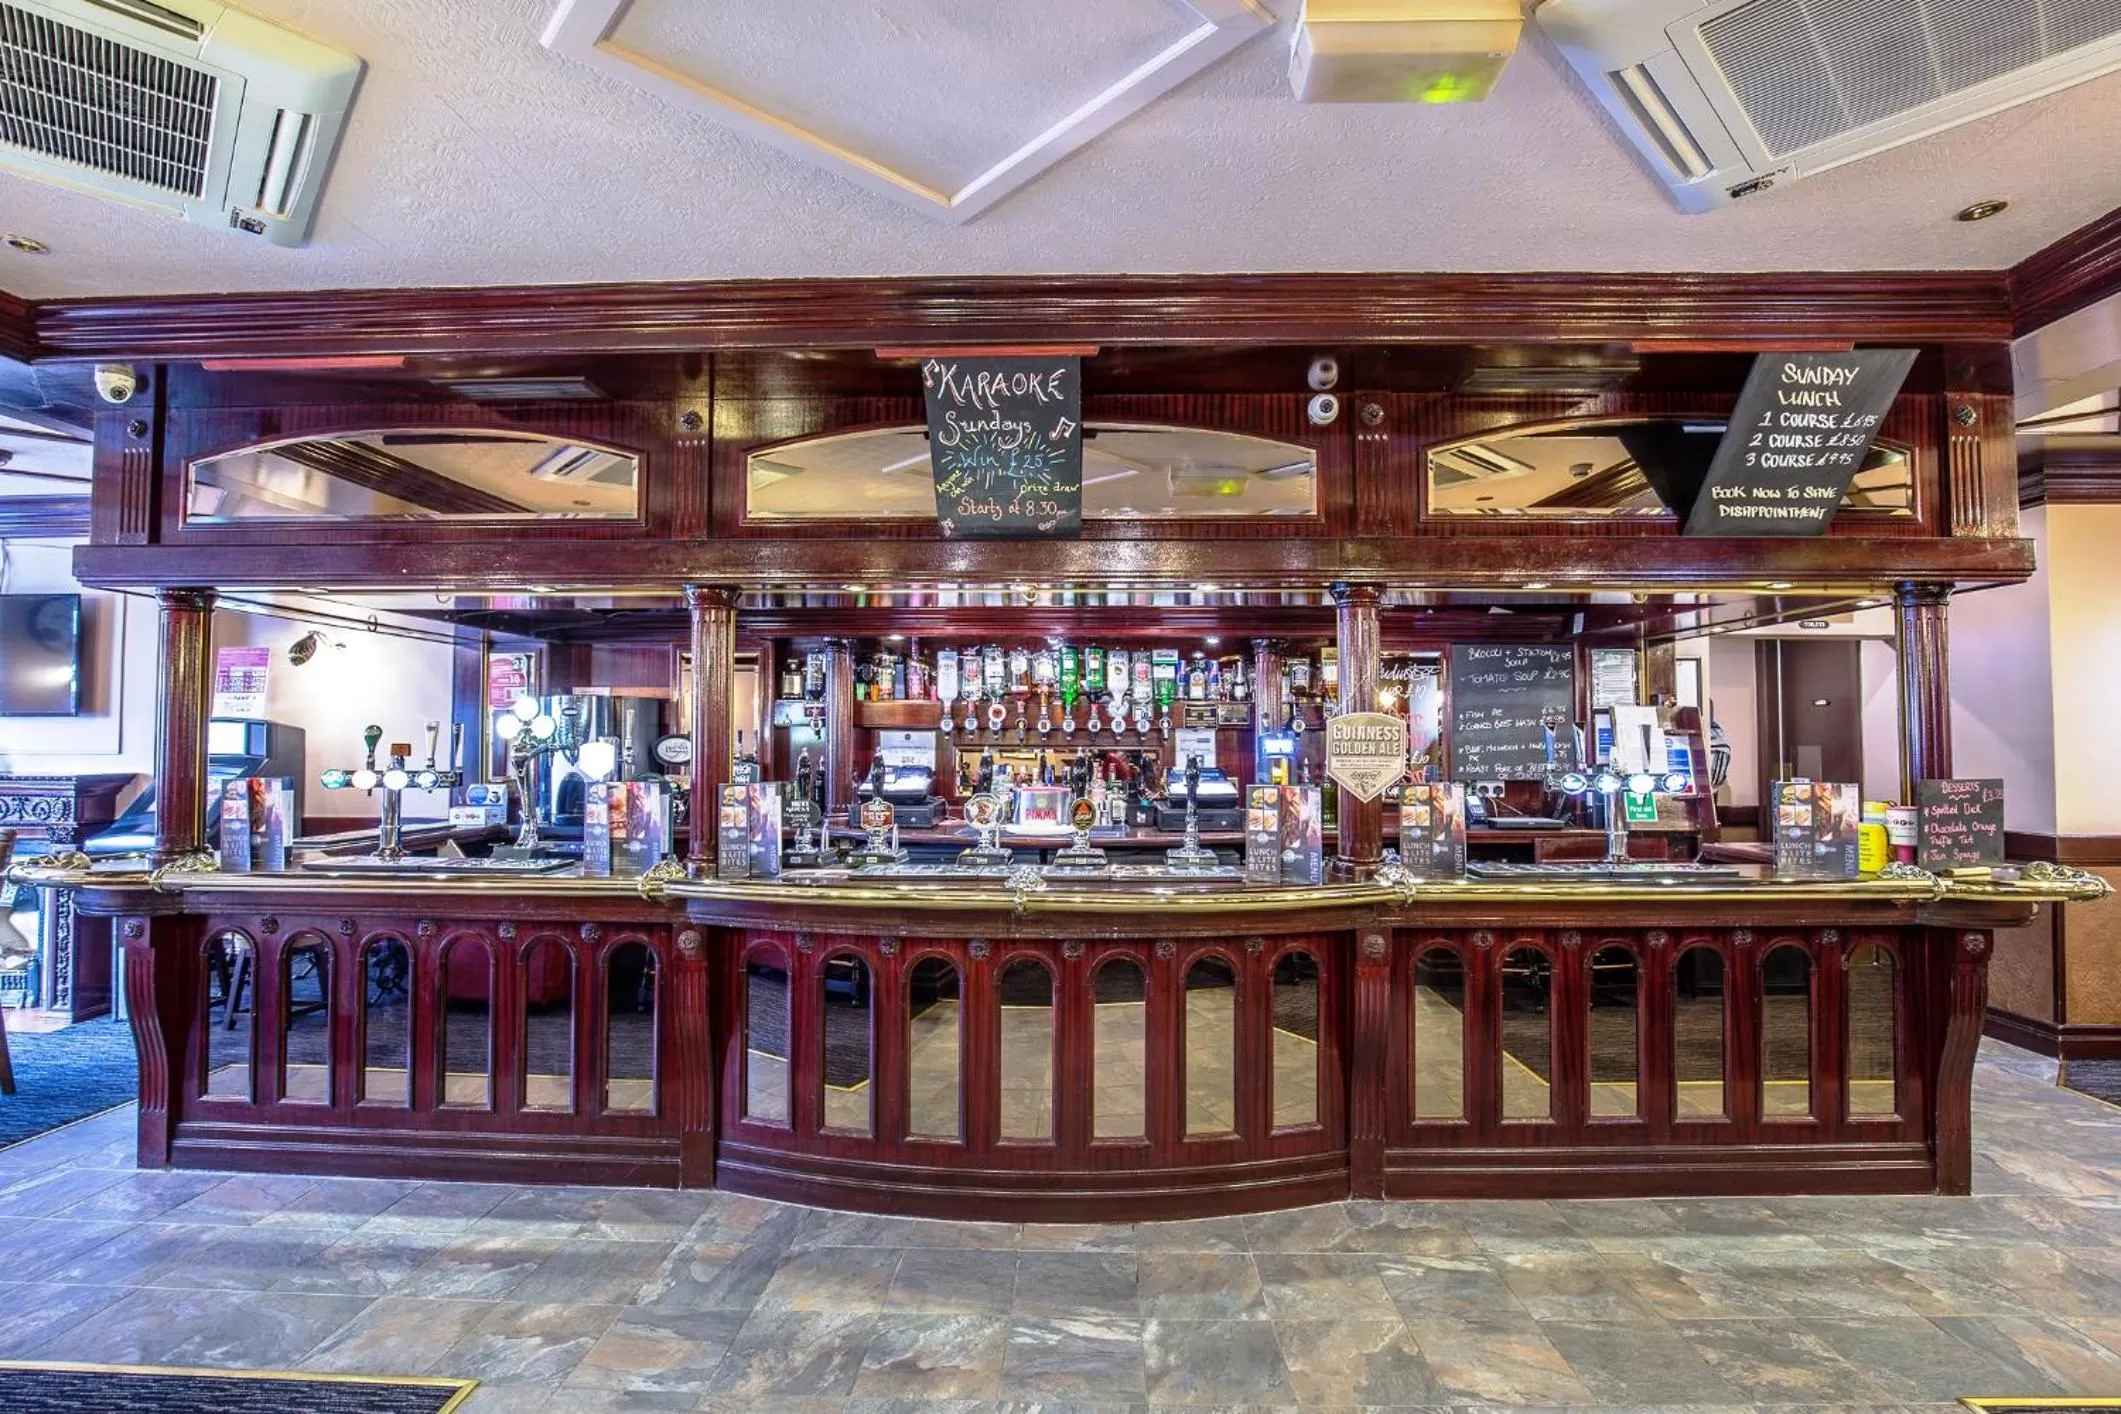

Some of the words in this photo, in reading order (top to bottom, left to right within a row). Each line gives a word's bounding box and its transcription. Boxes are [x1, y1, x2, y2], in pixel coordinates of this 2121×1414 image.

[1781, 362, 1860, 385] SUNDAY
[938, 364, 1066, 409] KARAOKE
[1778, 390, 1842, 407] LUNCH
[1757, 411, 1773, 427] 1
[1780, 412, 1839, 429] COURSE
[939, 410, 1032, 449] Sundays
[1748, 433, 1763, 447] 2
[1768, 434, 1823, 449] COURSE
[960, 445, 999, 468] Win
[1745, 453, 1756, 466] 3
[1761, 454, 1815, 469] COURSE
[1053, 481, 1080, 493] draw
[1711, 486, 1748, 499] BOOK
[958, 496, 1003, 520] Starts
[1008, 498, 1021, 515] at
[1719, 504, 1829, 520] DISAPPOINTMENT
[1513, 669, 1540, 681] SOUP
[1332, 724, 1400, 741] GUINNESS
[1332, 742, 1376, 756] GOLDEN
[1380, 742, 1400, 757] ALE
[1941, 781, 1981, 794] DESSERTS
[1248, 847, 1277, 856] LUNCH
[1781, 842, 1812, 850] LUNCH
[1309, 851, 1319, 883] MENU
